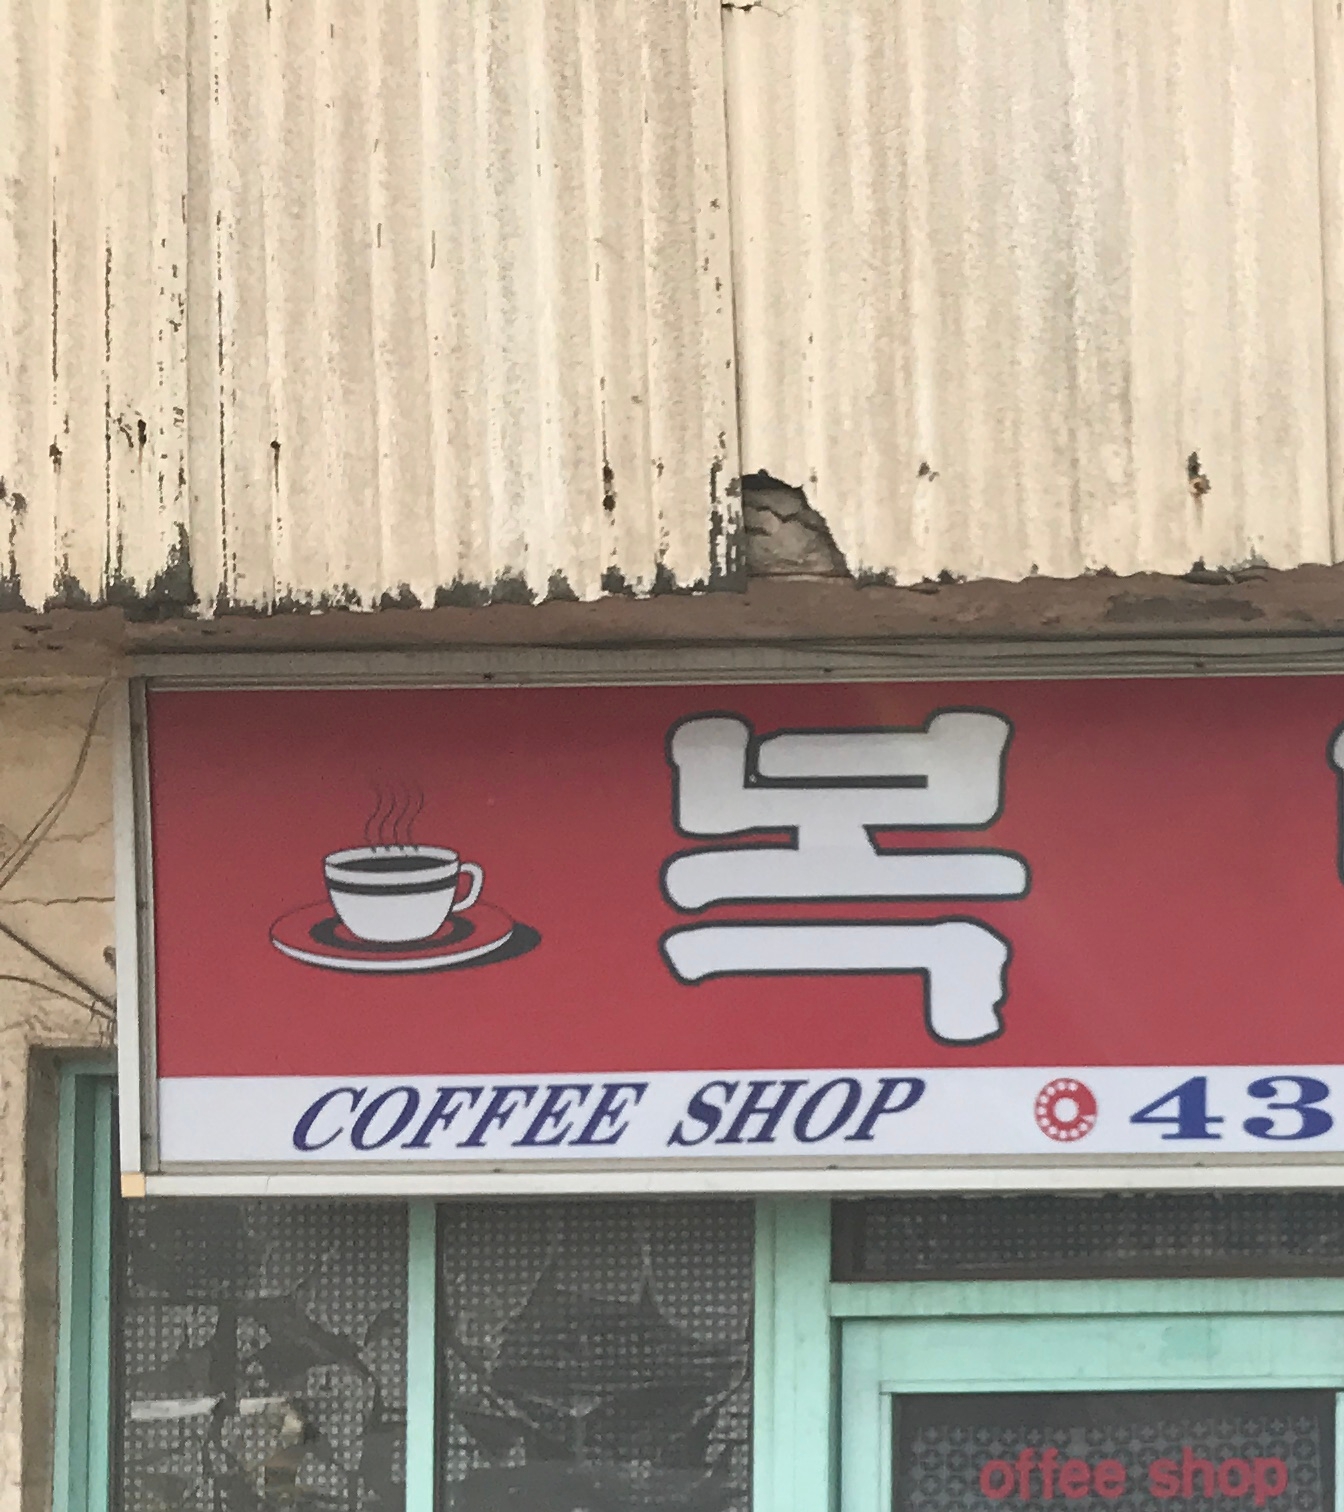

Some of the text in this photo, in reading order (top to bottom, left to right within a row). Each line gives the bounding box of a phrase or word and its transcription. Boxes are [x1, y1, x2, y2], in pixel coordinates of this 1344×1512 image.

[293, 1076, 926, 1151] COFFEE SHOP
[1147, 1446, 1288, 1507] shop
